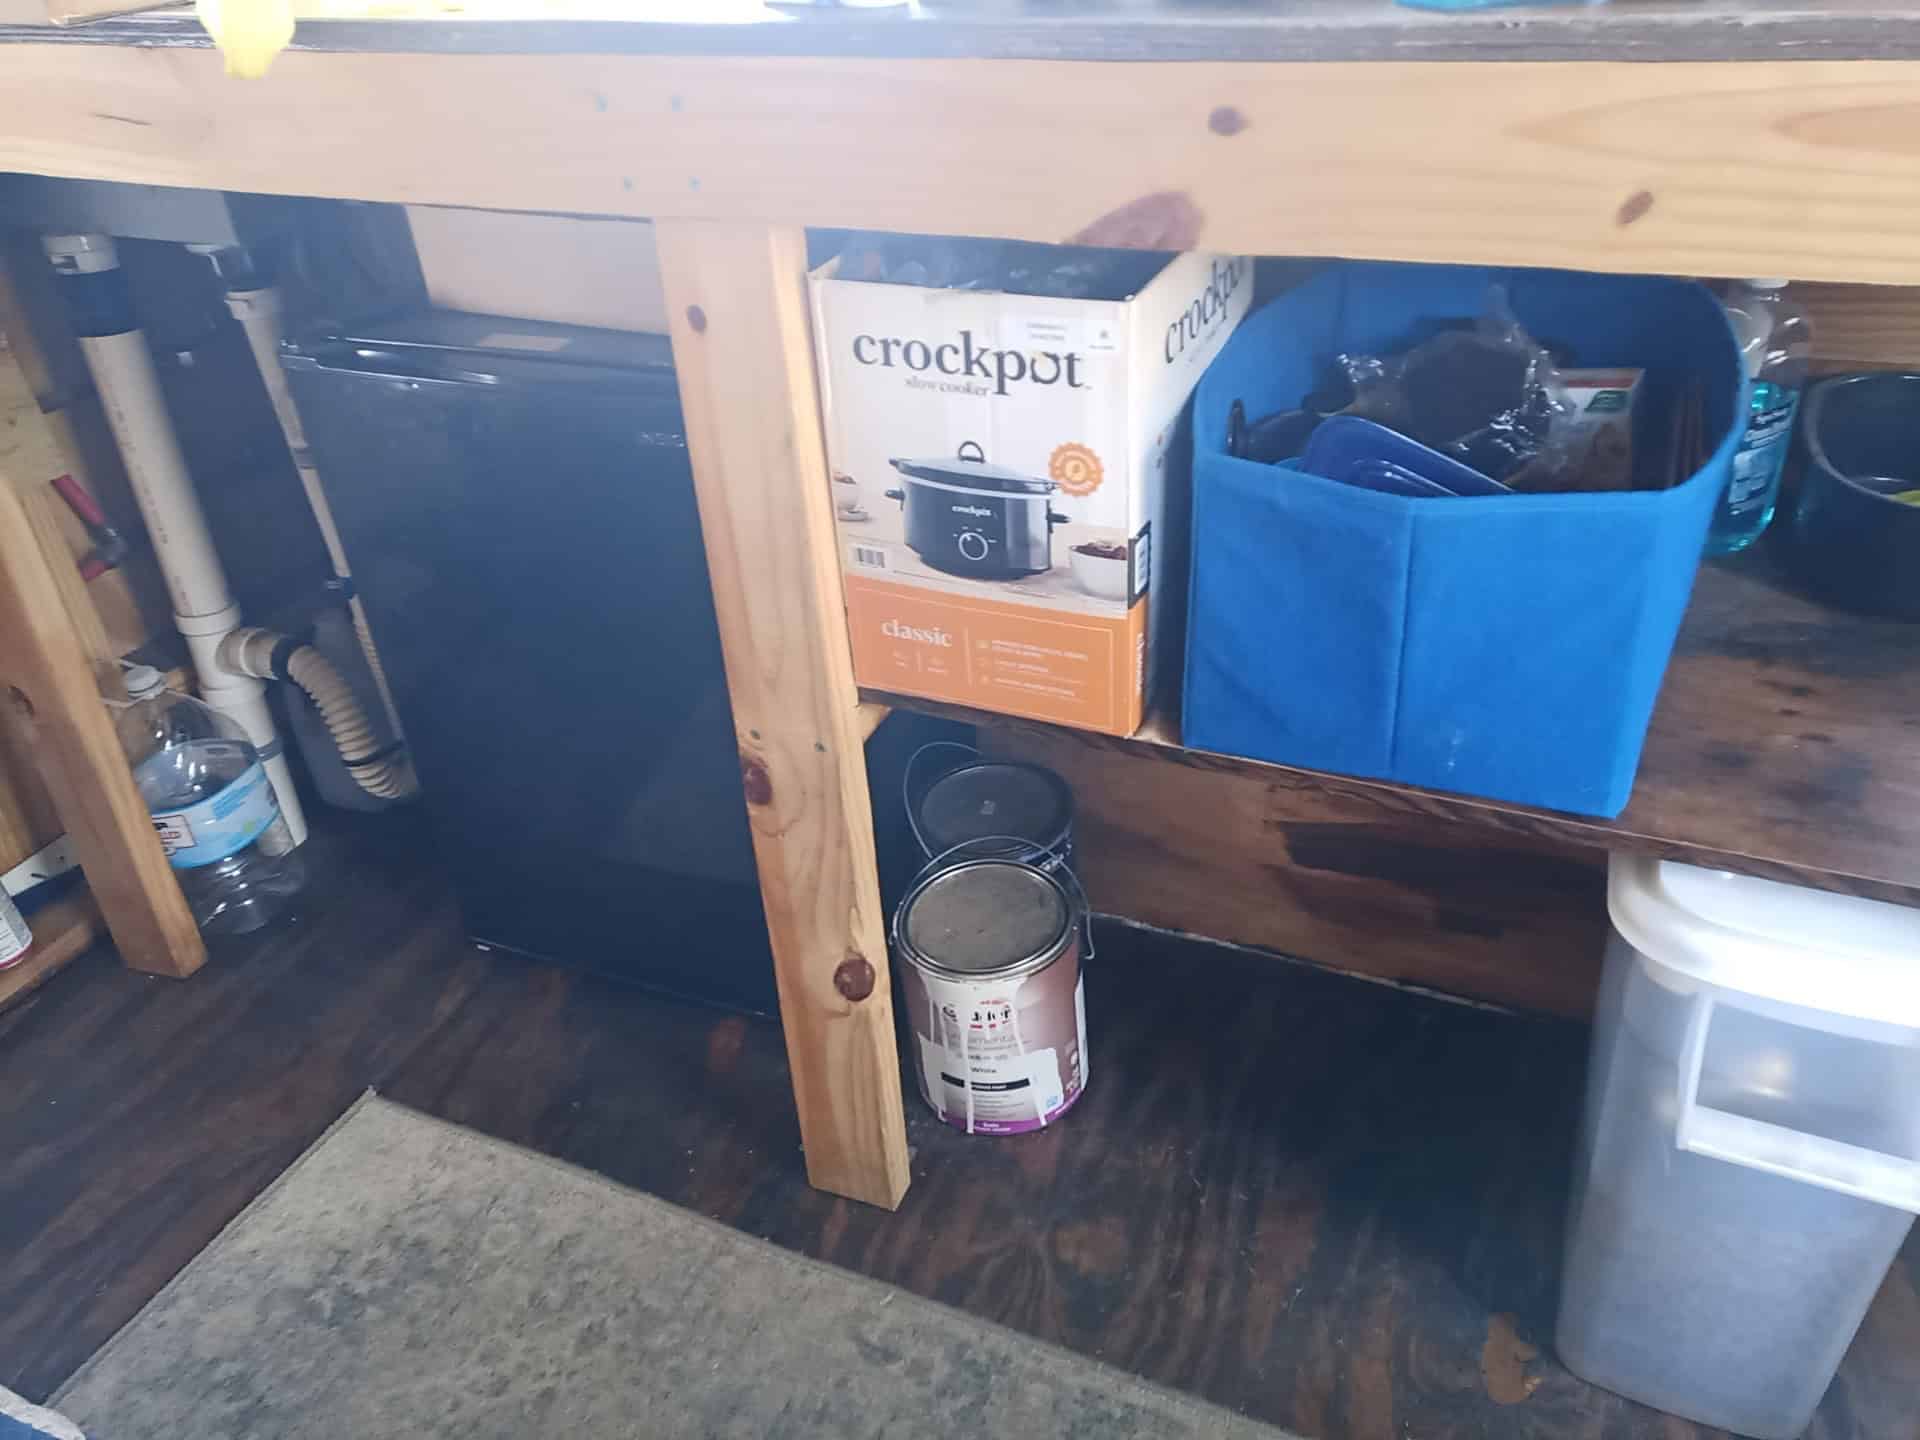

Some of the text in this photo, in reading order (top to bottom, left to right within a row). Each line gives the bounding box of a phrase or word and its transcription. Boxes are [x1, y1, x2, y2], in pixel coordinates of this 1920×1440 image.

[852, 329, 1085, 397] crockpot
[904, 375, 990, 397] slow cooker
[880, 618, 953, 648] classic
